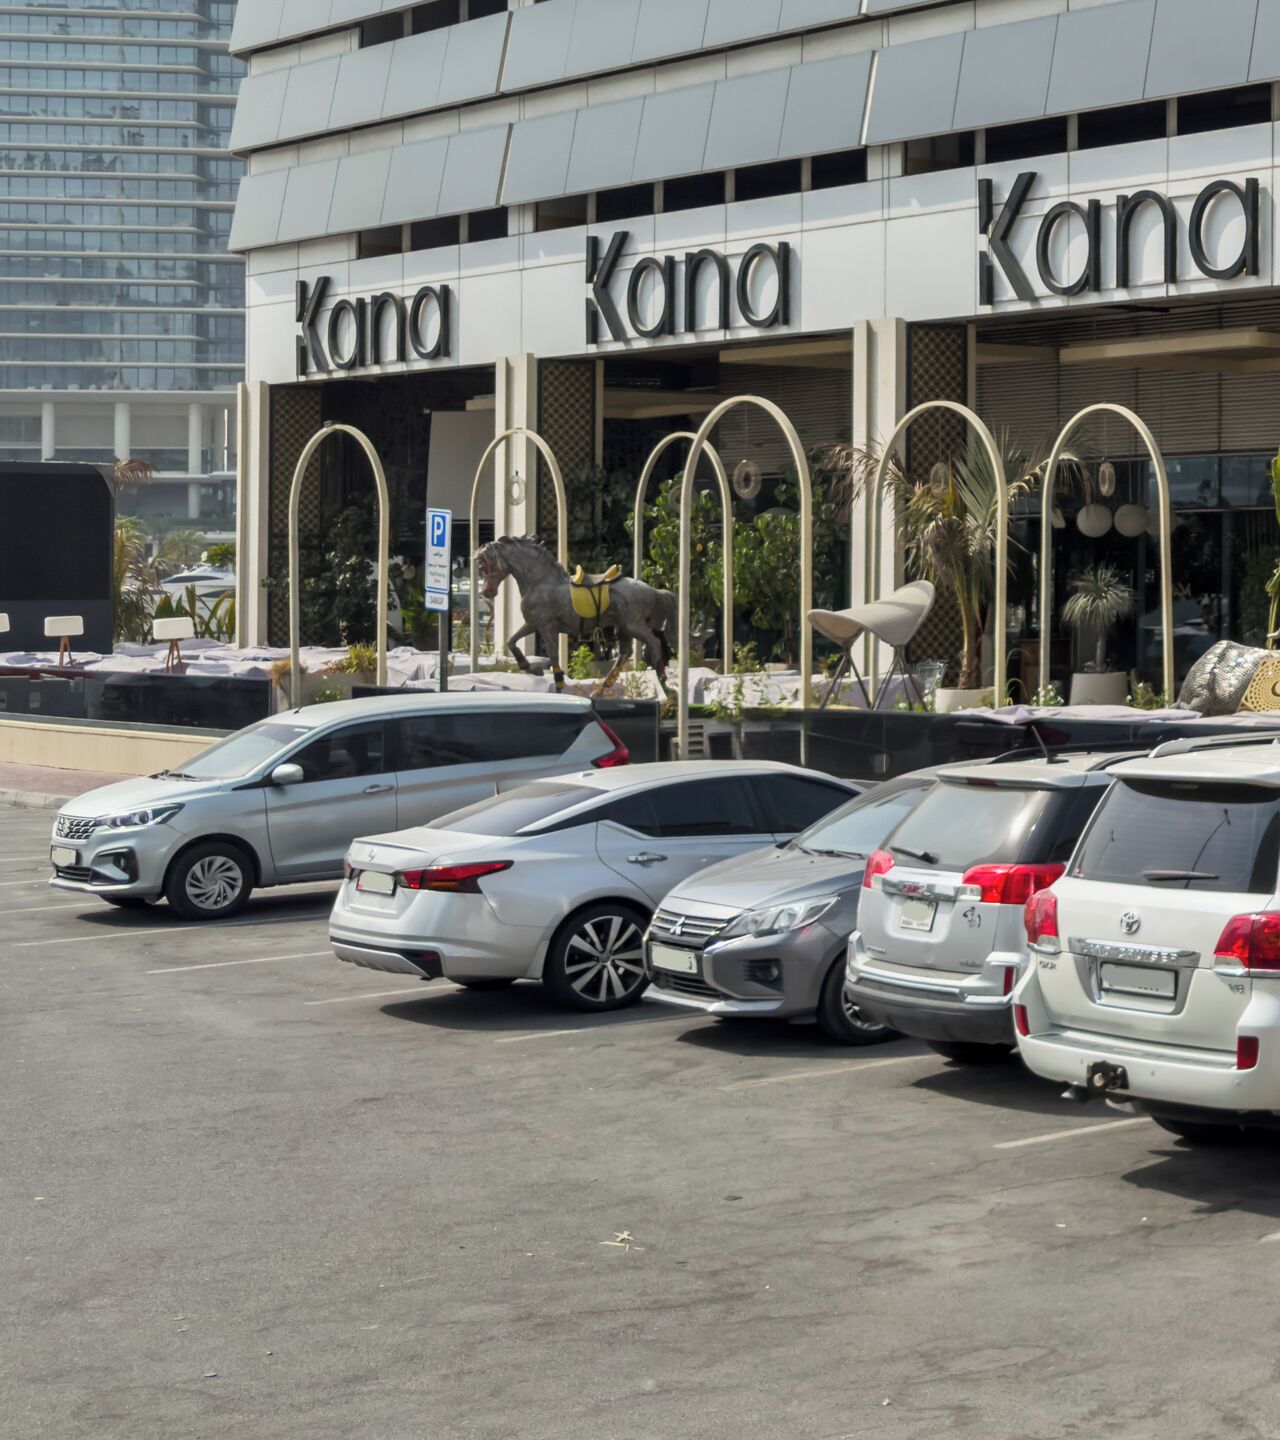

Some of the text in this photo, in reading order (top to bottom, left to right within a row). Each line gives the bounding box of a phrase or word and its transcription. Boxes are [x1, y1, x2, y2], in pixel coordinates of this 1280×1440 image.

[585, 231, 791, 345] Kana
[977, 171, 1260, 306] Kana
[295, 275, 451, 377] Kana
[433, 517, 444, 545] P
